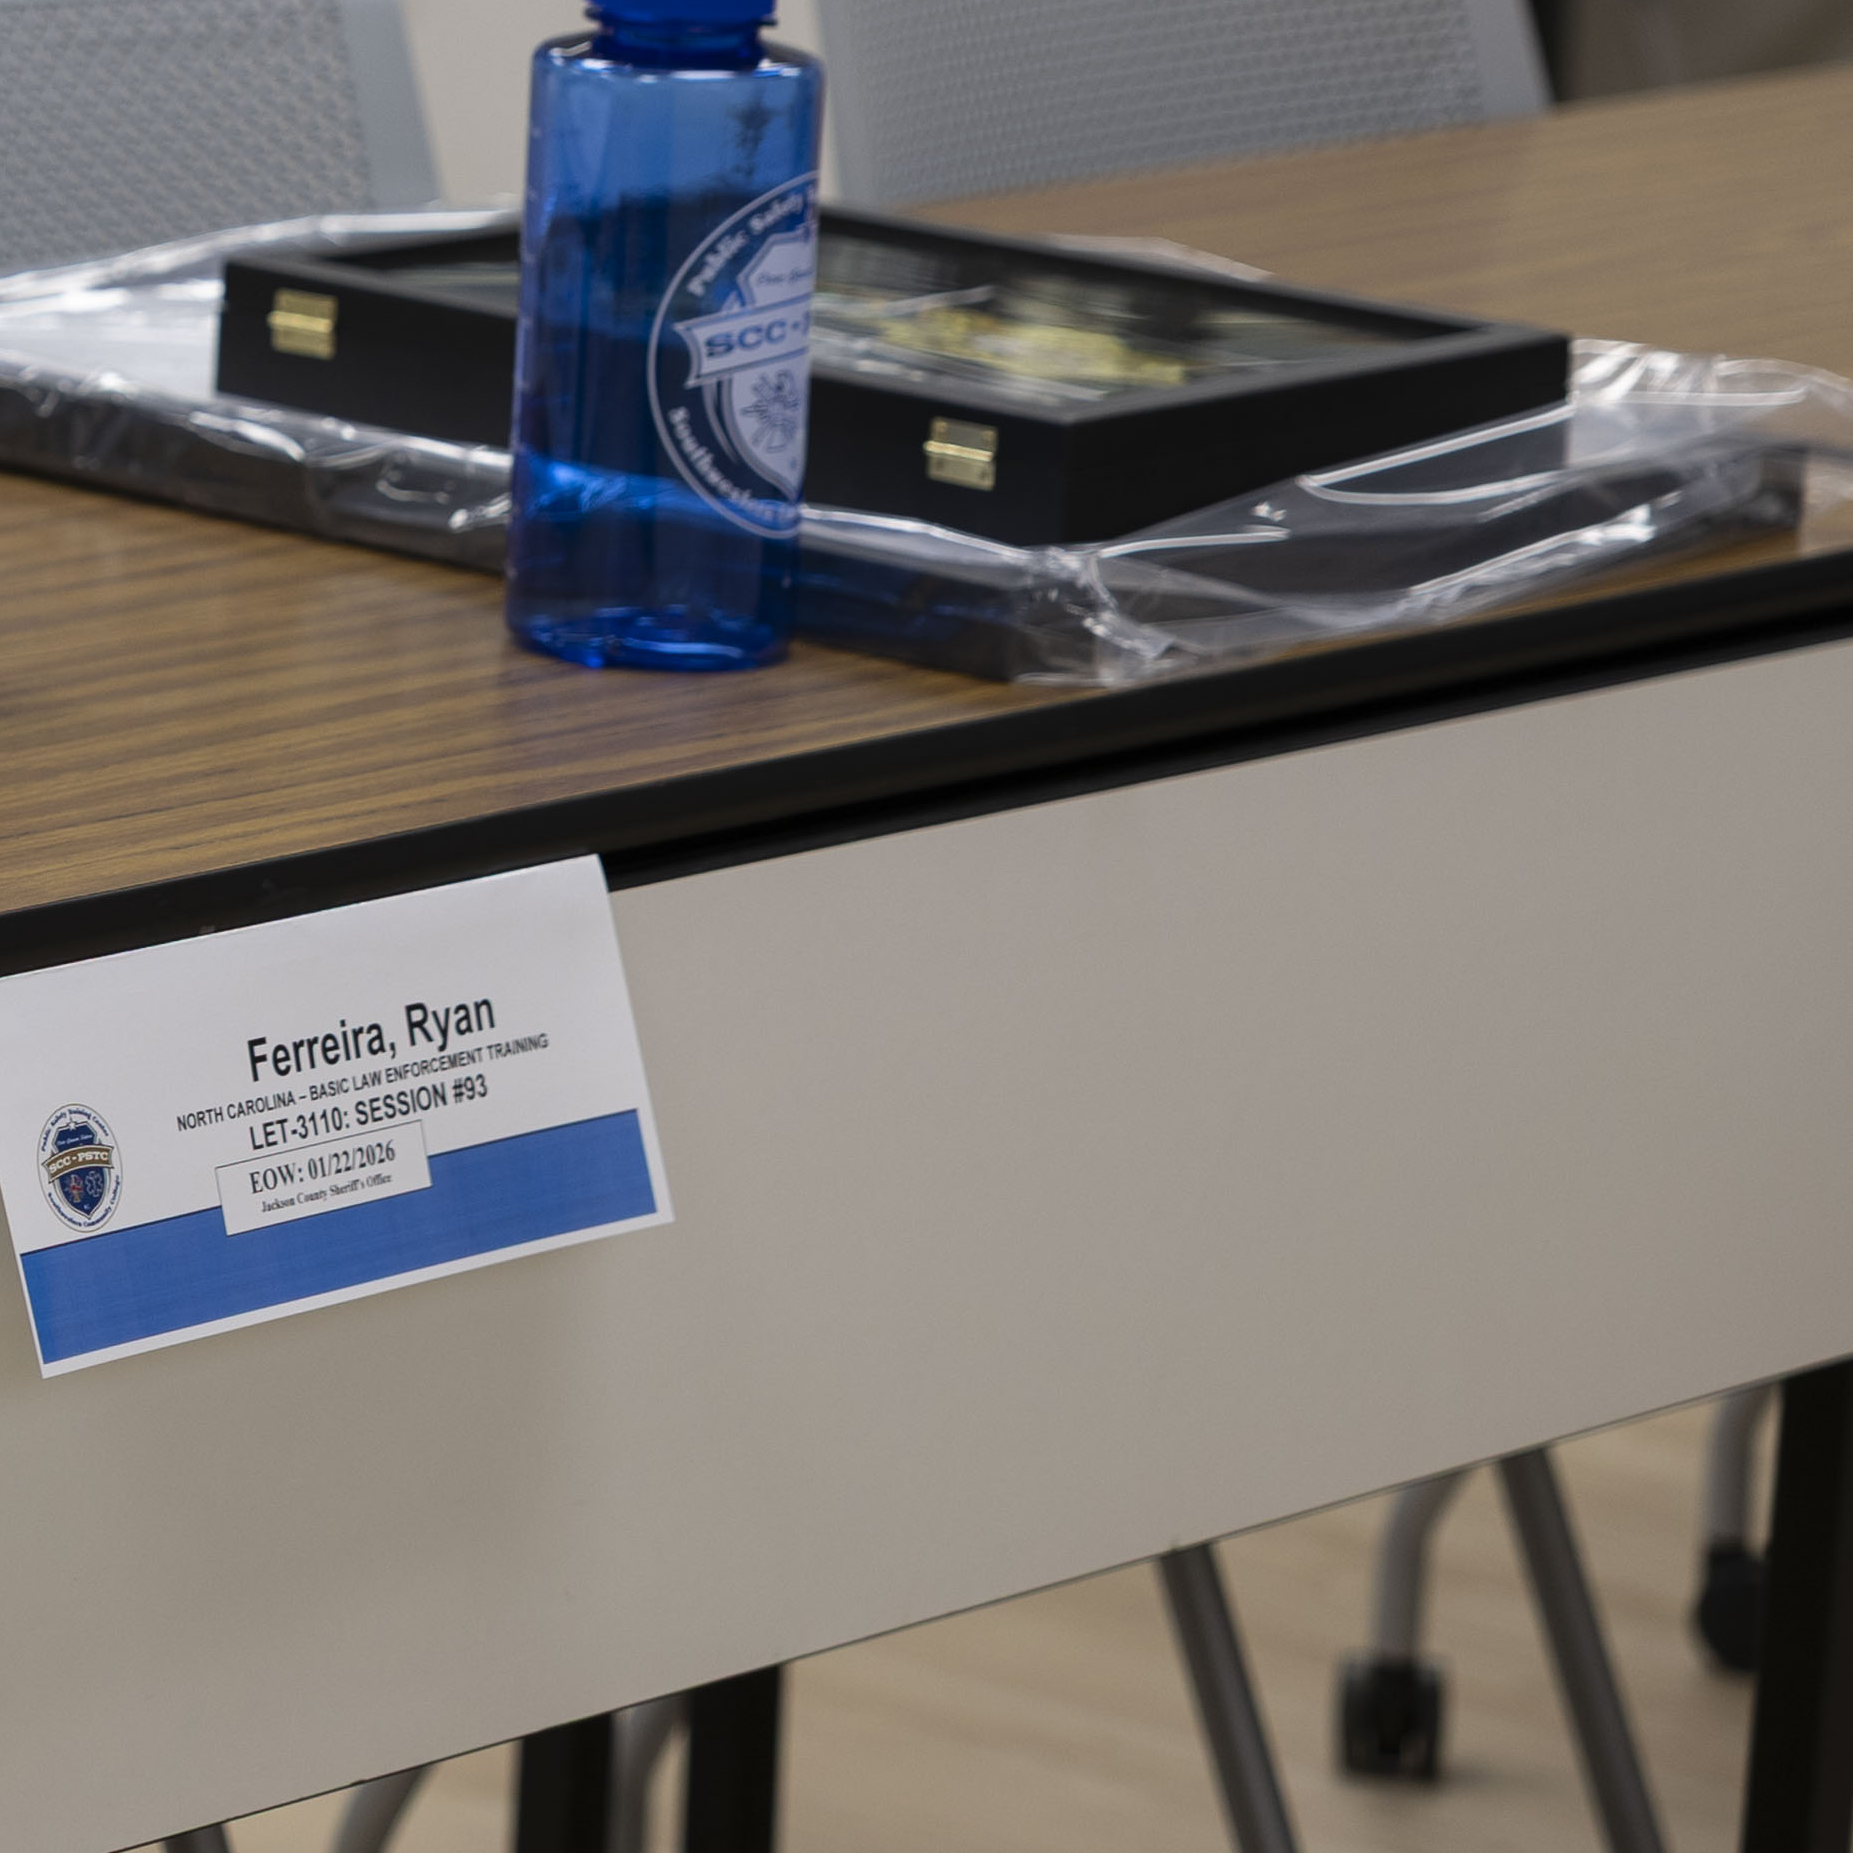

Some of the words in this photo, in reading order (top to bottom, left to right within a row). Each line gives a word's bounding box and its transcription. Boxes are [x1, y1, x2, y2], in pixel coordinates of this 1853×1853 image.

[246, 1019, 397, 1083] Ferreira,
[404, 998, 496, 1052] Ryan
[176, 1106, 225, 1132] NORTH
[226, 1089, 297, 1120] CAROLINA
[308, 1078, 350, 1102] BASIC
[352, 1070, 383, 1092] LAW
[385, 1048, 484, 1084] ENFORCEMENT
[486, 1032, 549, 1061] TRAINING
[249, 1105, 352, 1151] LET-3110:
[355, 1081, 449, 1126] SESSION
[452, 1073, 489, 1105] #93
[249, 1161, 305, 1195] EOW:
[307, 1139, 396, 1182] 01/22/2026
[260, 1196, 296, 1214] Jackson
[296, 1186, 328, 1208] County
[366, 1173, 393, 1193] Office
